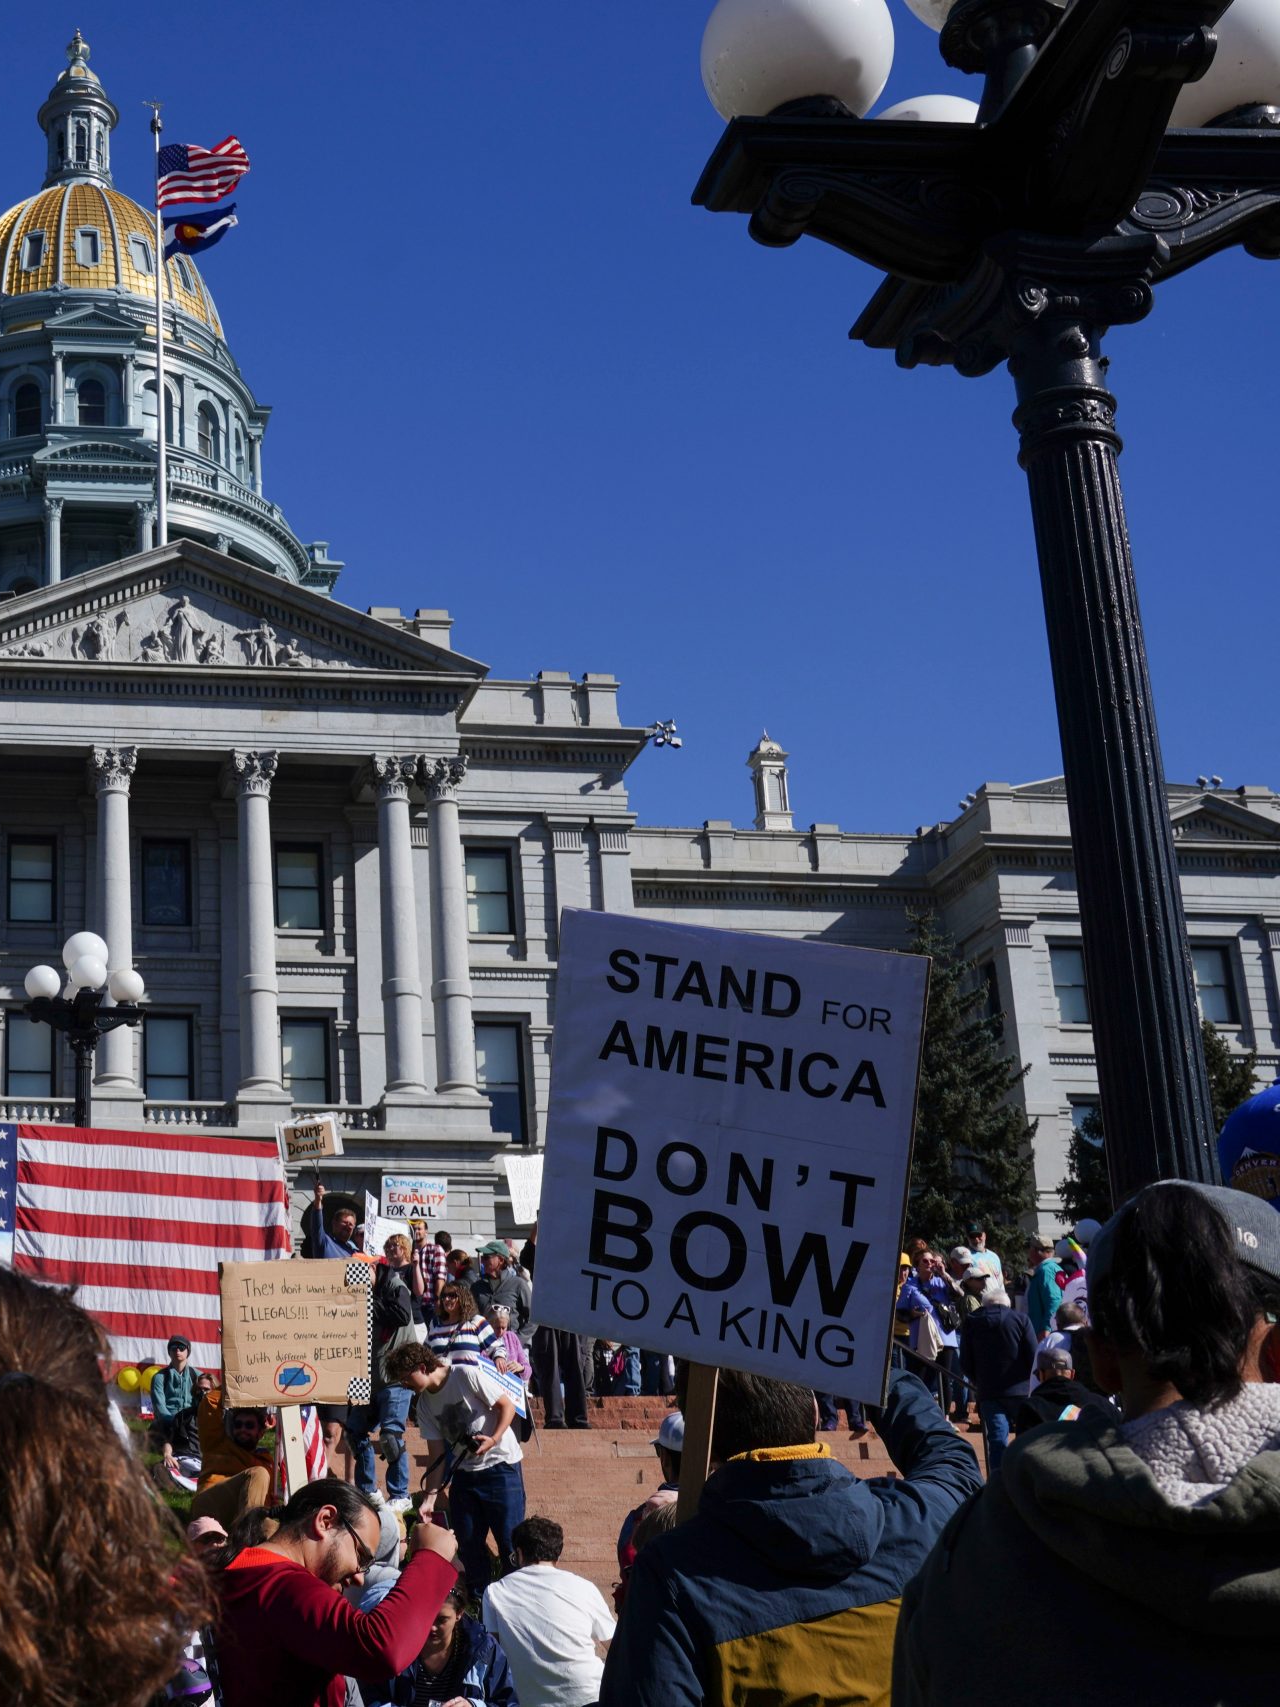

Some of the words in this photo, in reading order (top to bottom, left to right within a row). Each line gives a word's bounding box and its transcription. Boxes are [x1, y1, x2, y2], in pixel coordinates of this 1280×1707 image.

[605, 948, 802, 1019] STAND
[821, 1000, 893, 1035] FOR
[598, 1020, 887, 1109] AMERICA
[293, 1125, 324, 1139] DUMP
[287, 1137, 326, 1156] Donald
[593, 1126, 876, 1228] DON'T
[388, 1192, 446, 1205] EQUALITY
[386, 1205, 407, 1217] FOR
[410, 1205, 436, 1217] ALL
[588, 1189, 870, 1319] BOW
[240, 1278, 274, 1297] They
[330, 1284, 342, 1294] to
[239, 1305, 309, 1323] ILLEGALS!!!
[580, 1269, 650, 1321] TO
[663, 1292, 701, 1336] A
[719, 1301, 856, 1369] KING
[246, 1331, 257, 1341] to
